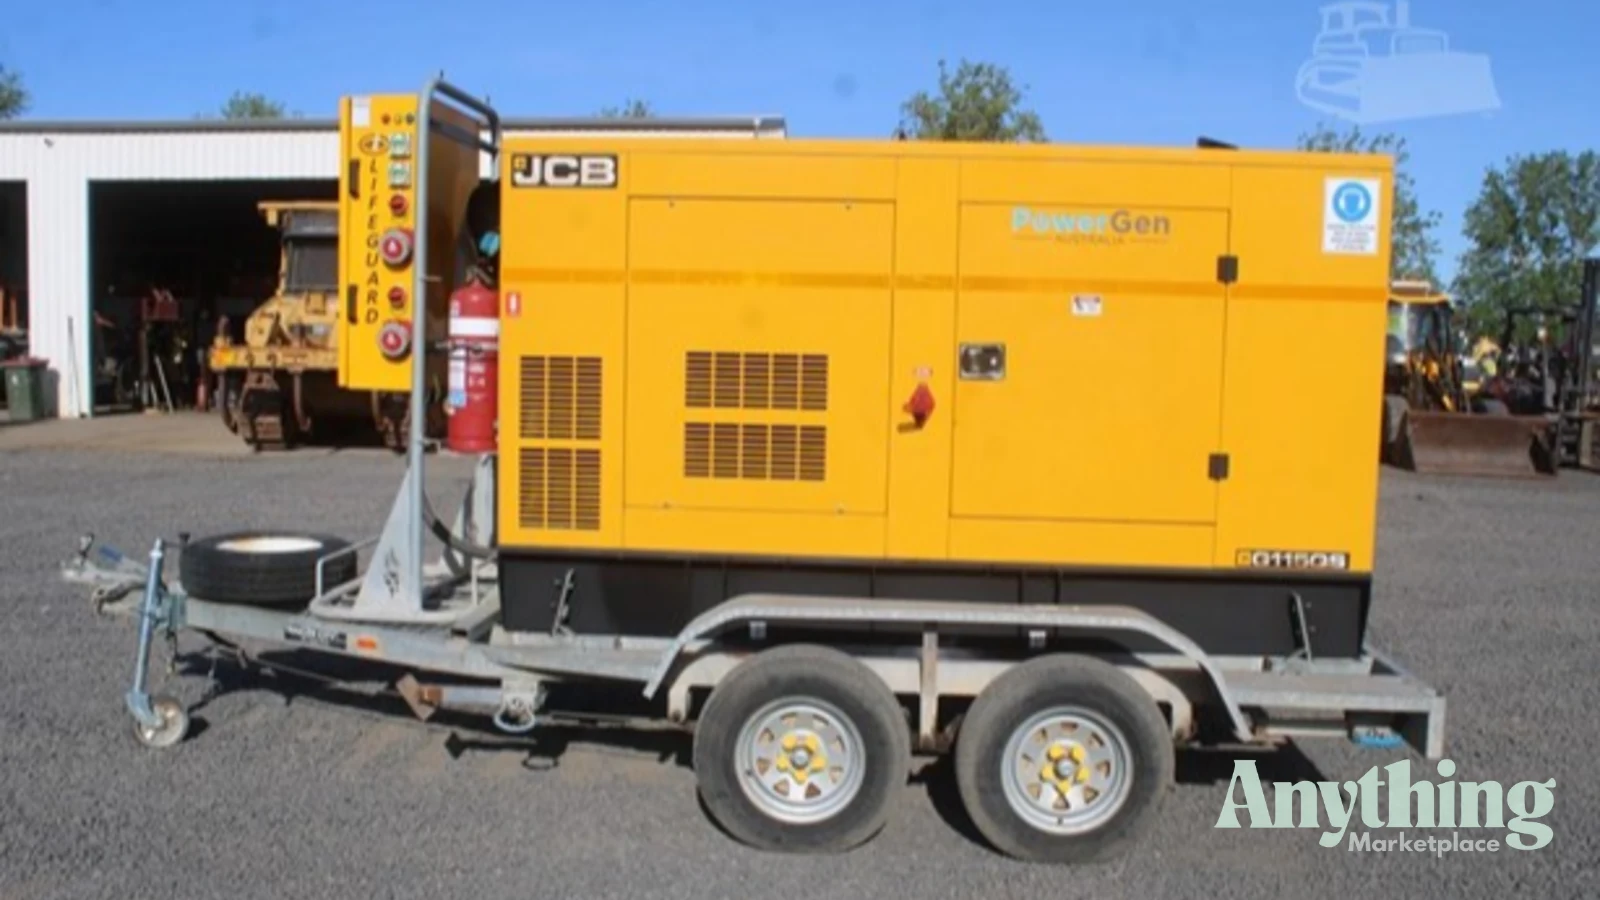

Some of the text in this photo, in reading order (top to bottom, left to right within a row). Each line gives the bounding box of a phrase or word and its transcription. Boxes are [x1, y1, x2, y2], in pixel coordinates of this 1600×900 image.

[513, 155, 616, 187] JCB
[1011, 206, 1170, 235] PowerGen
[366, 158, 379, 325] LIFEGUARD
